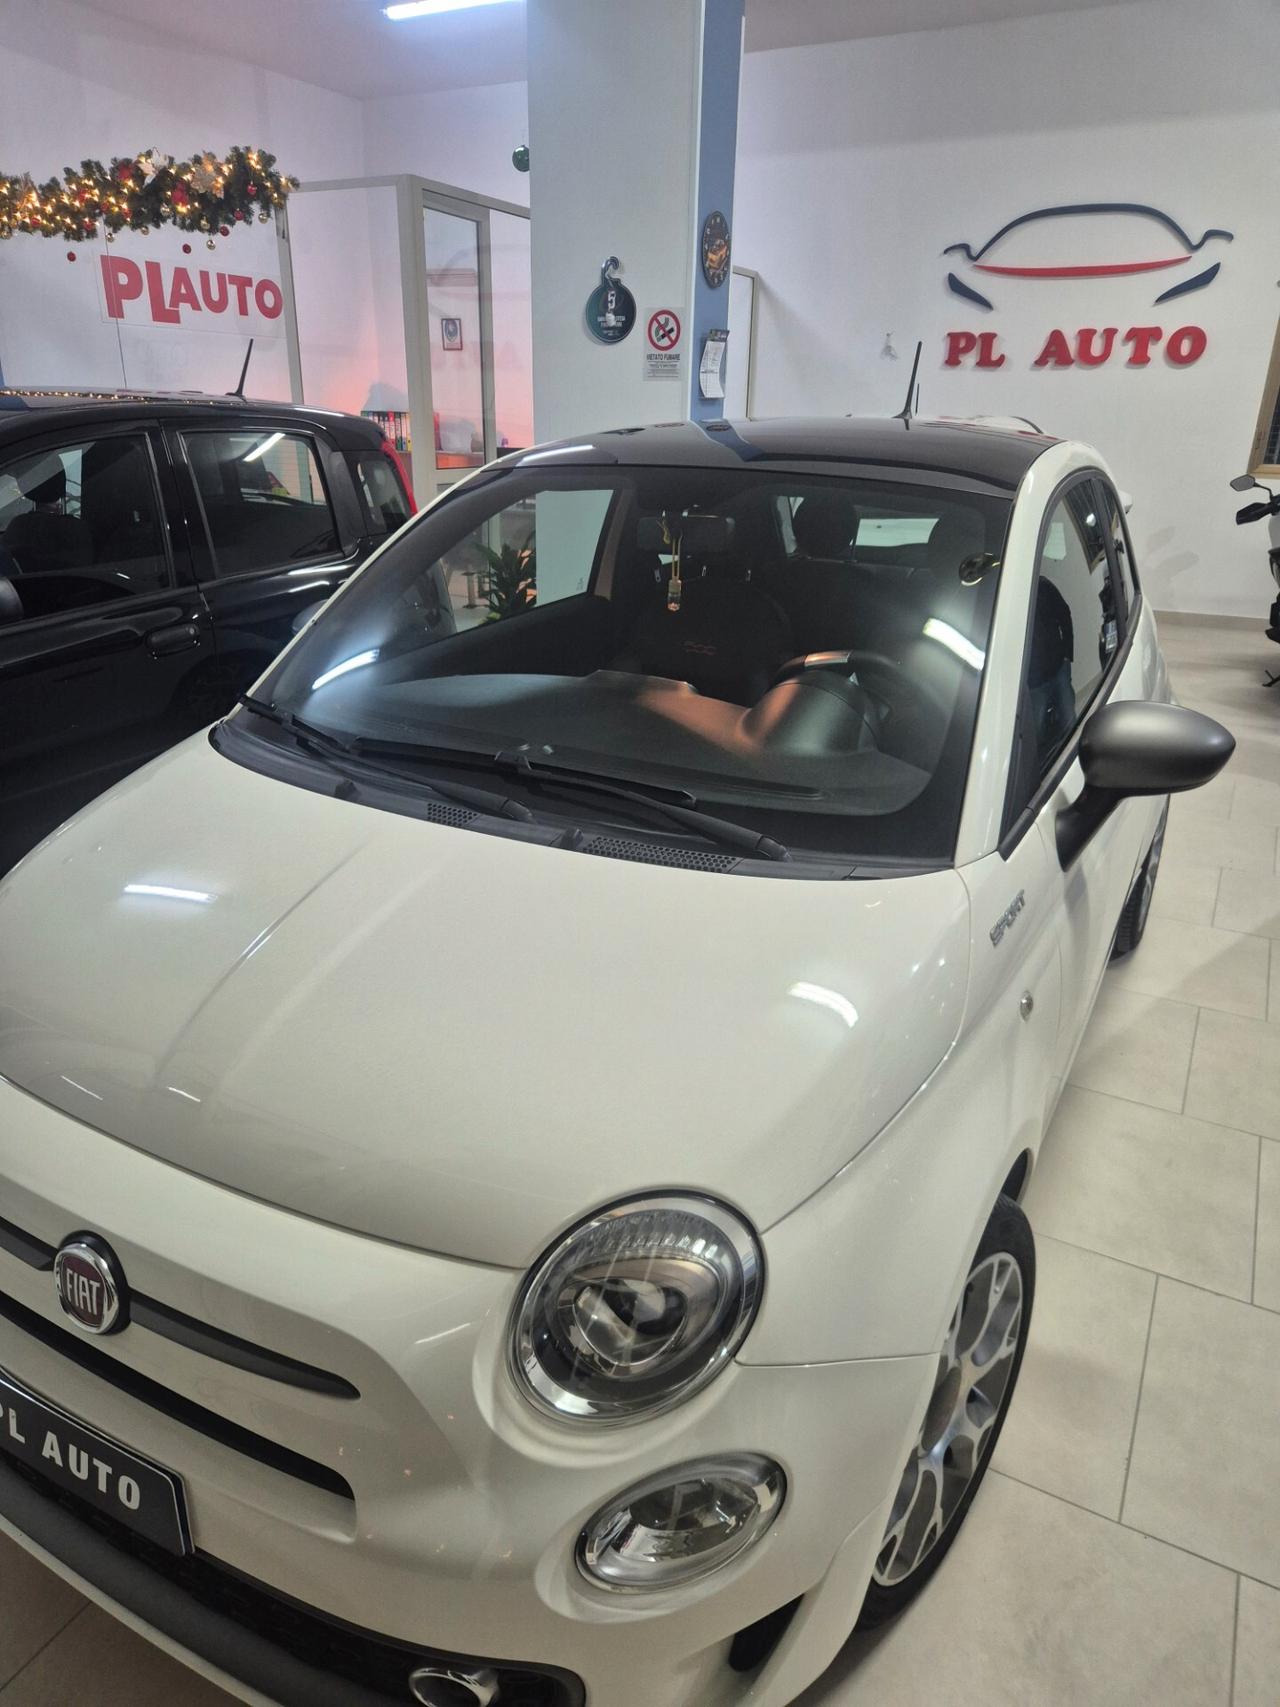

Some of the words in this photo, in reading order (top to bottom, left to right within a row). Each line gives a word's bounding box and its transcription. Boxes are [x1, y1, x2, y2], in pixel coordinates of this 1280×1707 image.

[944, 331, 1006, 368] PL
[1033, 325, 1208, 367] AUTO
[66, 1267, 101, 1316] FIAT
[41, 1430, 141, 1511] AUTO
